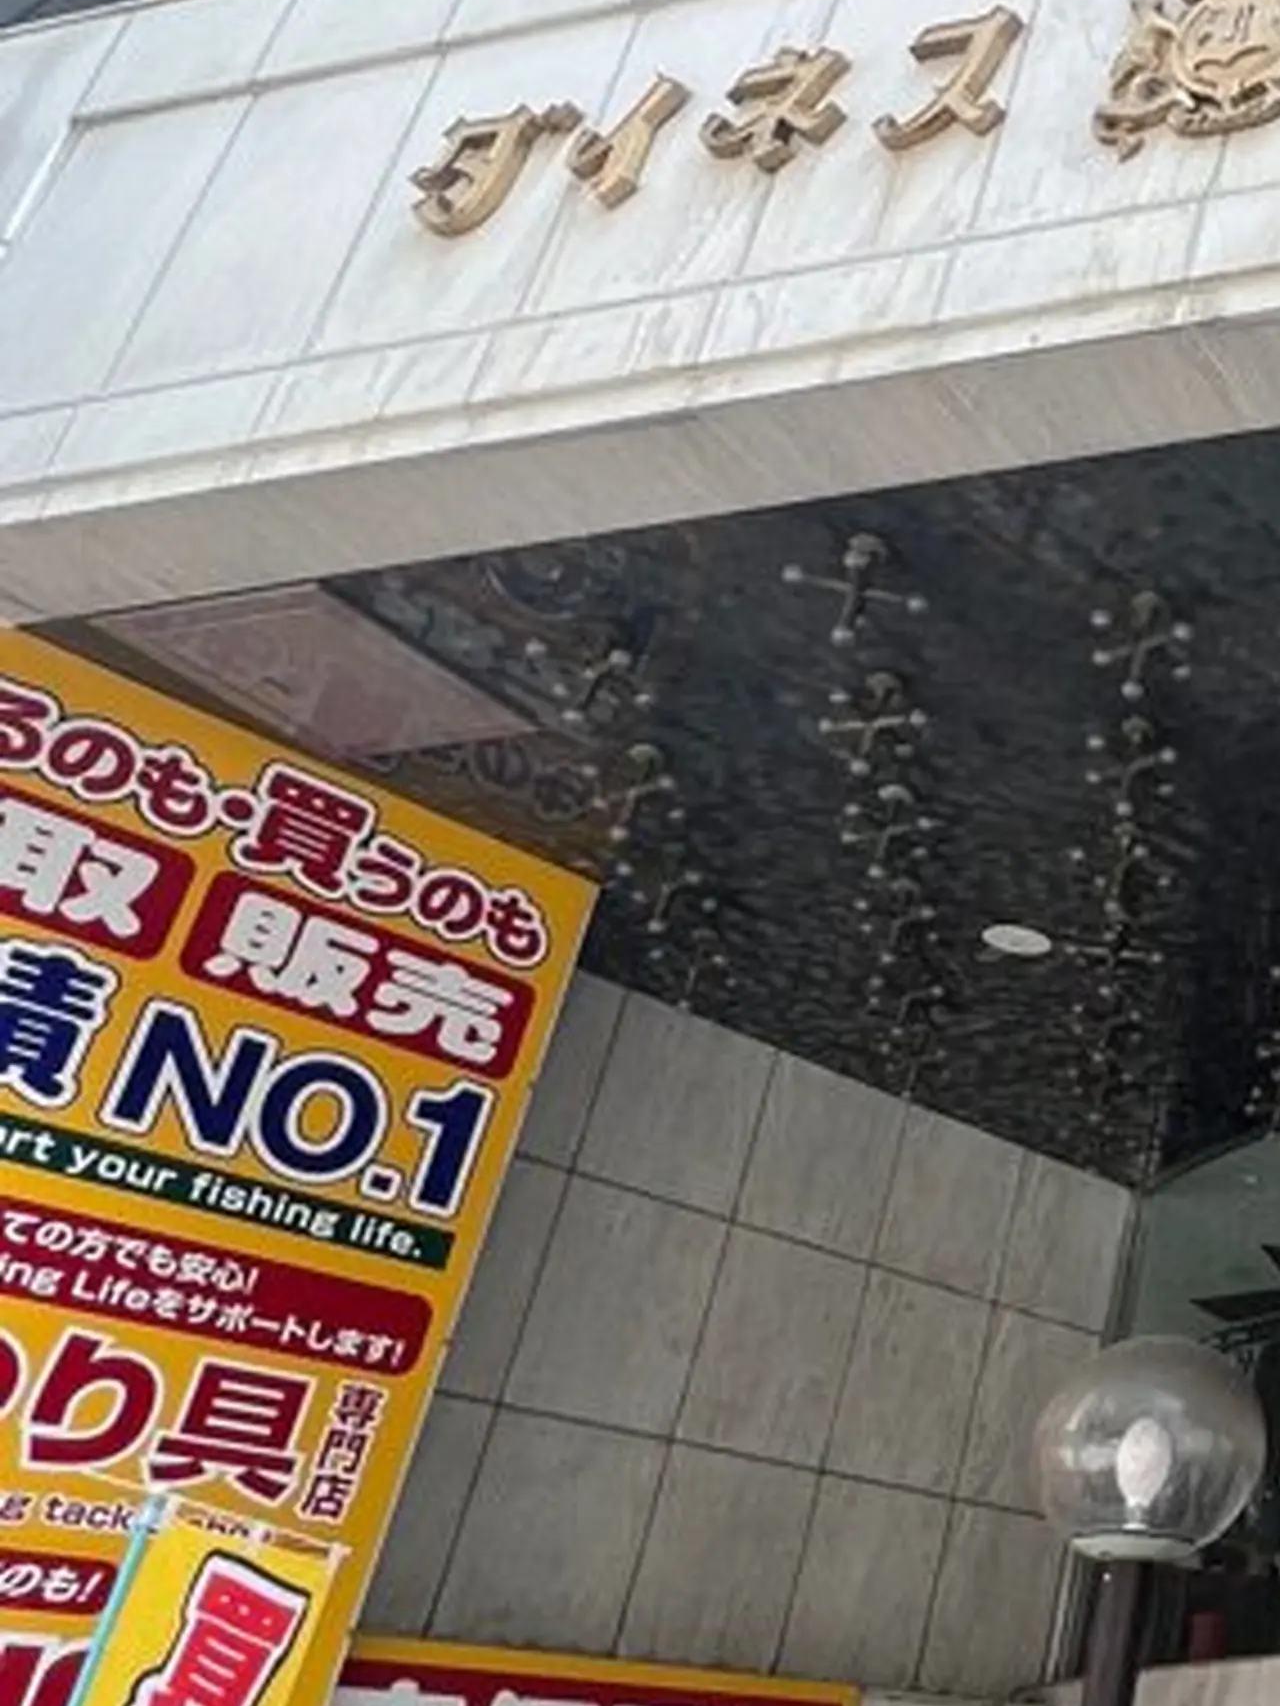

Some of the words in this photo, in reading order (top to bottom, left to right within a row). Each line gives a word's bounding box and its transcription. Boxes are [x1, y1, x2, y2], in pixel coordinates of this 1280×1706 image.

[203, 893, 516, 1067] 販売
[65, 1145, 179, 1192] your
[187, 1171, 344, 1237] fishing
[349, 1213, 423, 1258] life.
[0, 1329, 314, 1505] り具
[297, 1379, 386, 1519] 専門店
